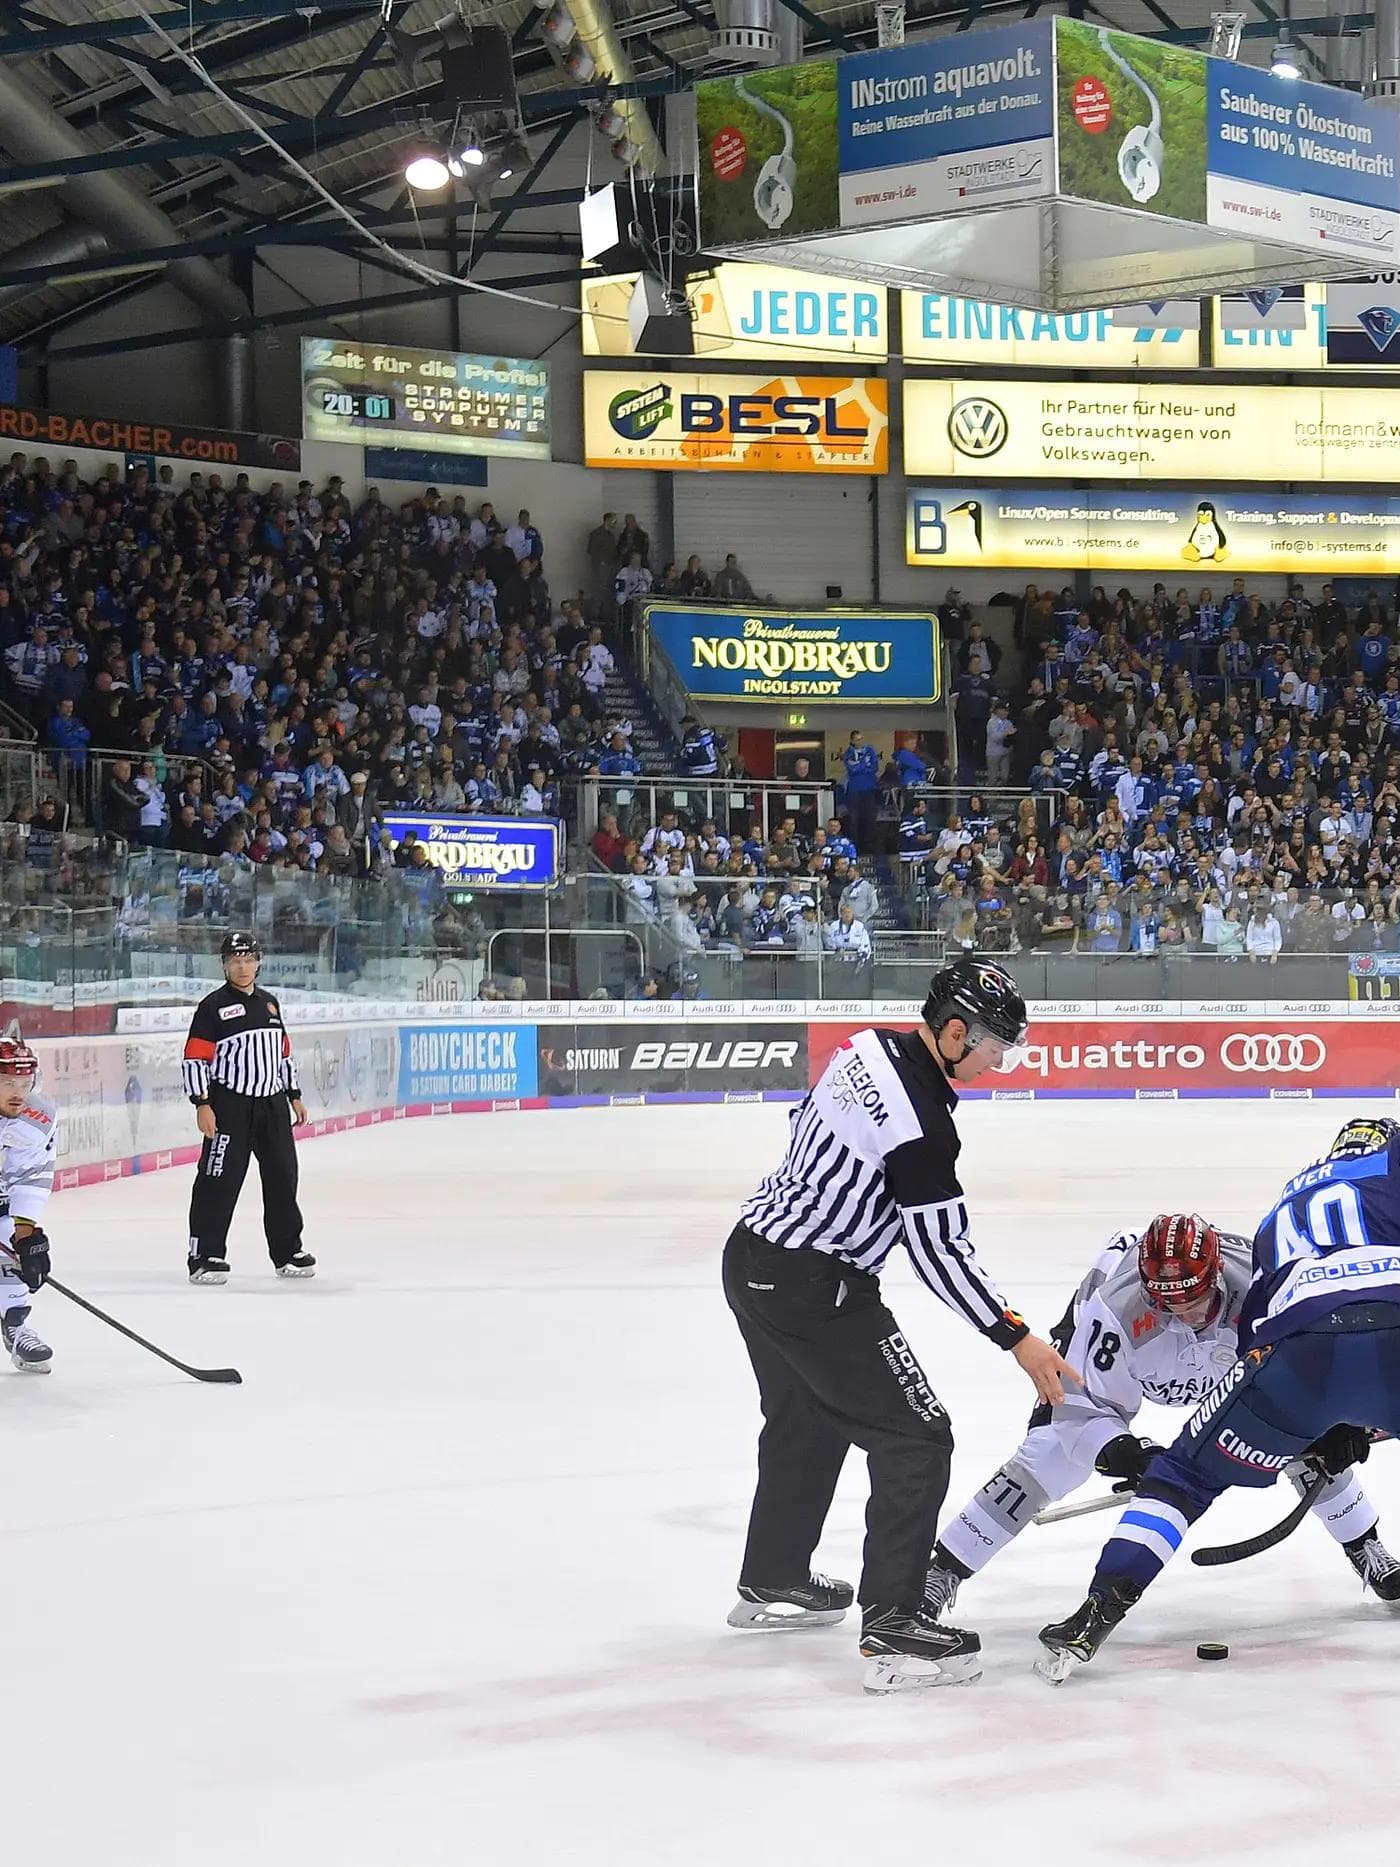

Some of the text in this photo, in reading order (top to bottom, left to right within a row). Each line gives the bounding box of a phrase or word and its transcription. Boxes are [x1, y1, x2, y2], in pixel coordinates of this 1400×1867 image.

[851, 48, 1041, 109] INstrom aquavolt.
[852, 91, 1042, 137] Reine Wasserkraft aus der Donau.
[1220, 88, 1372, 144] Sauberer Ökostrom
[1221, 122, 1394, 178] aus 100% Wasserkraft!
[947, 157, 1015, 180] STADTWERKE
[855, 186, 917, 206] www.sw-i.de
[1222, 199, 1282, 222] www.sw-i.de
[1309, 205, 1371, 230] STADTWERKE
[741, 290, 878, 338] JEDER
[314, 350, 366, 371] Zeit
[372, 355, 412, 375] für
[418, 359, 457, 378] die
[405, 398, 545, 420] COMPUTER
[616, 383, 664, 419] SYSTEM
[1041, 400, 1235, 417] Ihr Partner für Neu- und
[412, 411, 539, 433] SYSTEME
[640, 407, 666, 429] LIFT
[681, 394, 869, 437] BESL
[1042, 422, 1231, 442] Gebrauchtwagen von
[1042, 447, 1155, 465] Volkswagen.
[999, 506, 1179, 523] Linux/Open Source Consulting,
[1226, 510, 1276, 524] Training,
[1277, 511, 1324, 526] Support
[1327, 512, 1337, 523] &
[691, 637, 892, 679] NORDBRÄU
[743, 679, 842, 695] INGOLSTADT
[882, 1004, 905, 1012] Audi
[1033, 1004, 1054, 1012] Audi
[1115, 1004, 1137, 1012] Audi
[1200, 1004, 1221, 1012] Audi
[1283, 1004, 1305, 1012] Audi
[1367, 1004, 1390, 1012] Audi
[410, 1032, 517, 1072] BODYCHECK
[566, 1049, 620, 1070] SATURN
[1023, 1040, 1206, 1076] quattro
[452, 1074, 517, 1093] CARD DABEI?
[843, 1053, 889, 1127] TELEKOM
[1275, 1181, 1369, 1270] 40
[1146, 1276, 1199, 1290] STETSON
[1087, 1319, 1121, 1371] 18
[877, 1338, 932, 1423] Hotels & Resorts
[888, 1331, 945, 1417] Dorint
[1189, 1361, 1245, 1437] SATURN
[1217, 1428, 1294, 1470] CINQUE
[983, 1472, 1027, 1522] ETL
